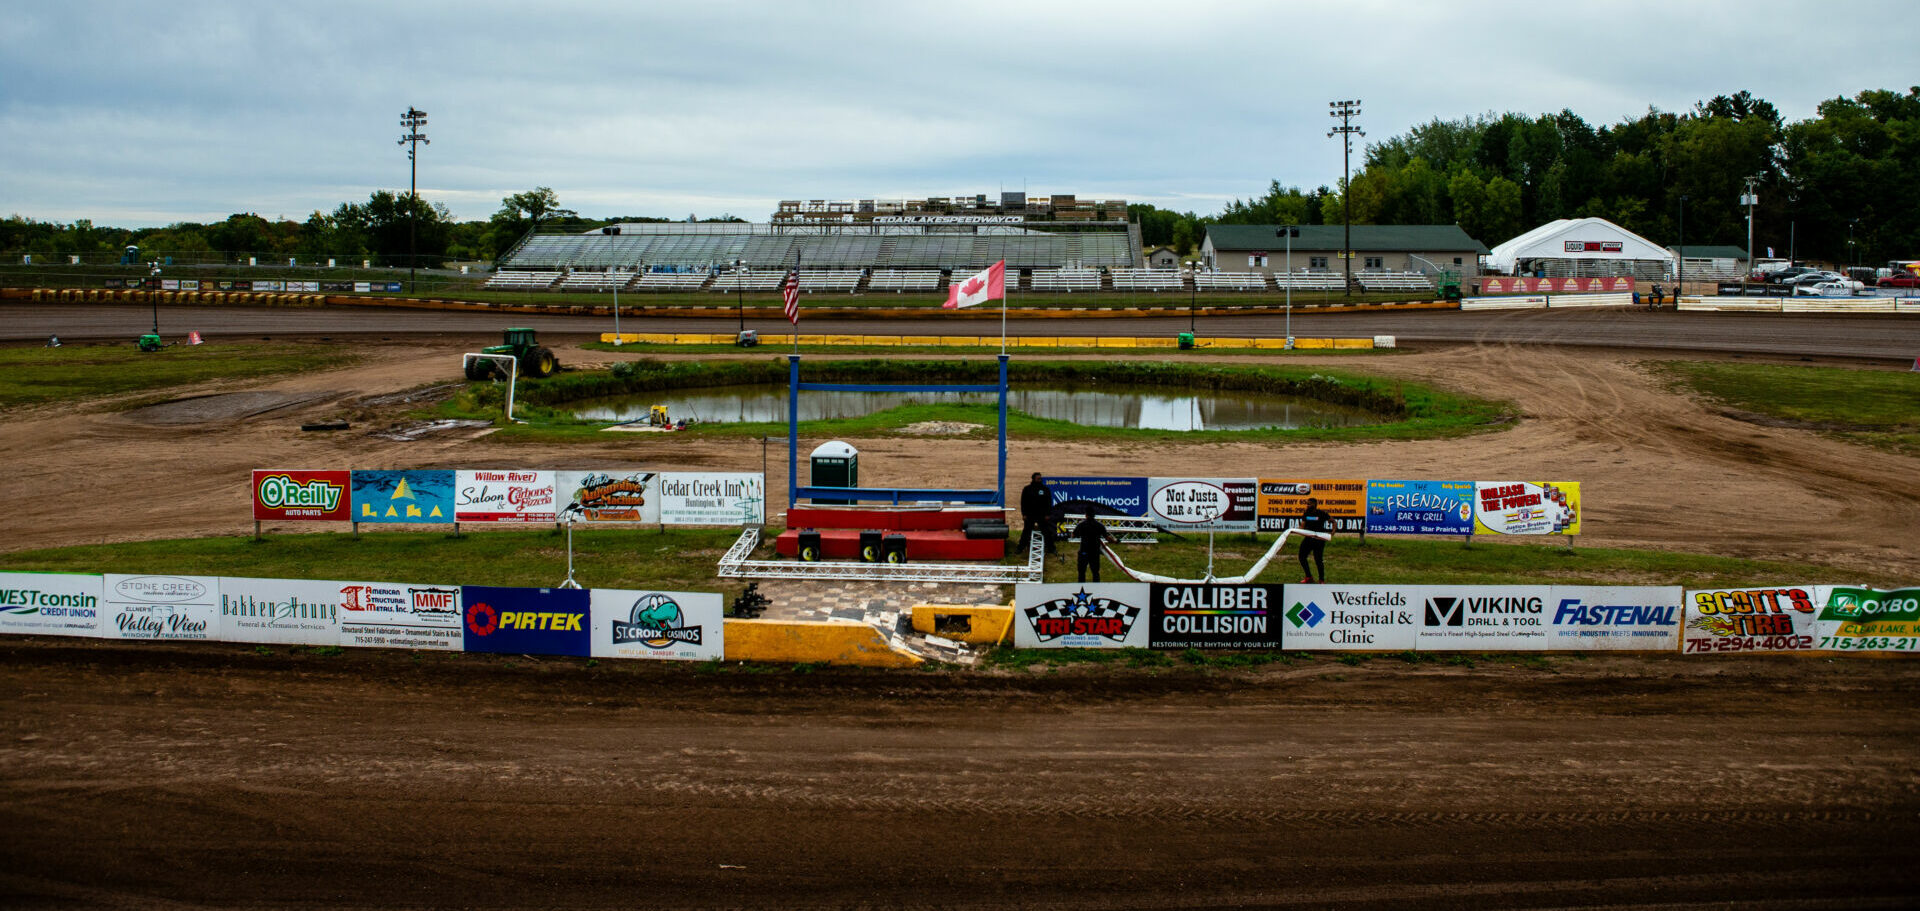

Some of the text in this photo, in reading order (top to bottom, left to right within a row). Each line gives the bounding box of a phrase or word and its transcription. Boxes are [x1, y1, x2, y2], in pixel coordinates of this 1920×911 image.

[475, 472, 533, 482] Willow River
[263, 479, 340, 506] O'Reilly
[456, 485, 505, 506] Saloon
[661, 479, 742, 497] Cedar Creek Inn
[1166, 489, 1218, 502] Not Justa
[1480, 483, 1525, 500] UNLEASH
[1387, 493, 1459, 512] FRIENDLY
[1481, 494, 1541, 512] THE POWER!
[1167, 506, 1184, 516] BAR
[1397, 512, 1413, 520] BAR
[1422, 513, 1443, 521] GRILL
[1260, 518, 1286, 529] EVERY
[1347, 519, 1363, 530] DAY
[121, 582, 158, 590] STONE
[416, 594, 452, 608] MMF
[1163, 586, 1268, 609] CALIBER
[1331, 591, 1407, 606] Westfields
[1467, 597, 1543, 614] VIKING
[1695, 588, 1816, 615] SCOTT'S
[40, 607, 96, 618] CREDIT UNION
[222, 594, 337, 624] Bakken Young
[1552, 599, 1677, 626] FASTENAL
[115, 612, 206, 637] Valley View
[237, 620, 259, 628] Funeral
[300, 622, 325, 630] Services
[499, 611, 584, 631] PIRTEK
[1037, 618, 1124, 635] TRI STAR
[1162, 615, 1267, 634] COLLISION
[1330, 610, 1414, 628] Hospital &
[1467, 618, 1542, 626] DRILL & TOOL
[405, 629, 431, 637] Ornamental
[432, 630, 445, 638] Stairs
[451, 631, 462, 639] Rails
[666, 629, 700, 641] CASINOS
[1329, 629, 1375, 644] Clinic
[1844, 624, 1877, 635] CLEAR
[1243, 641, 1262, 649] YOUR
